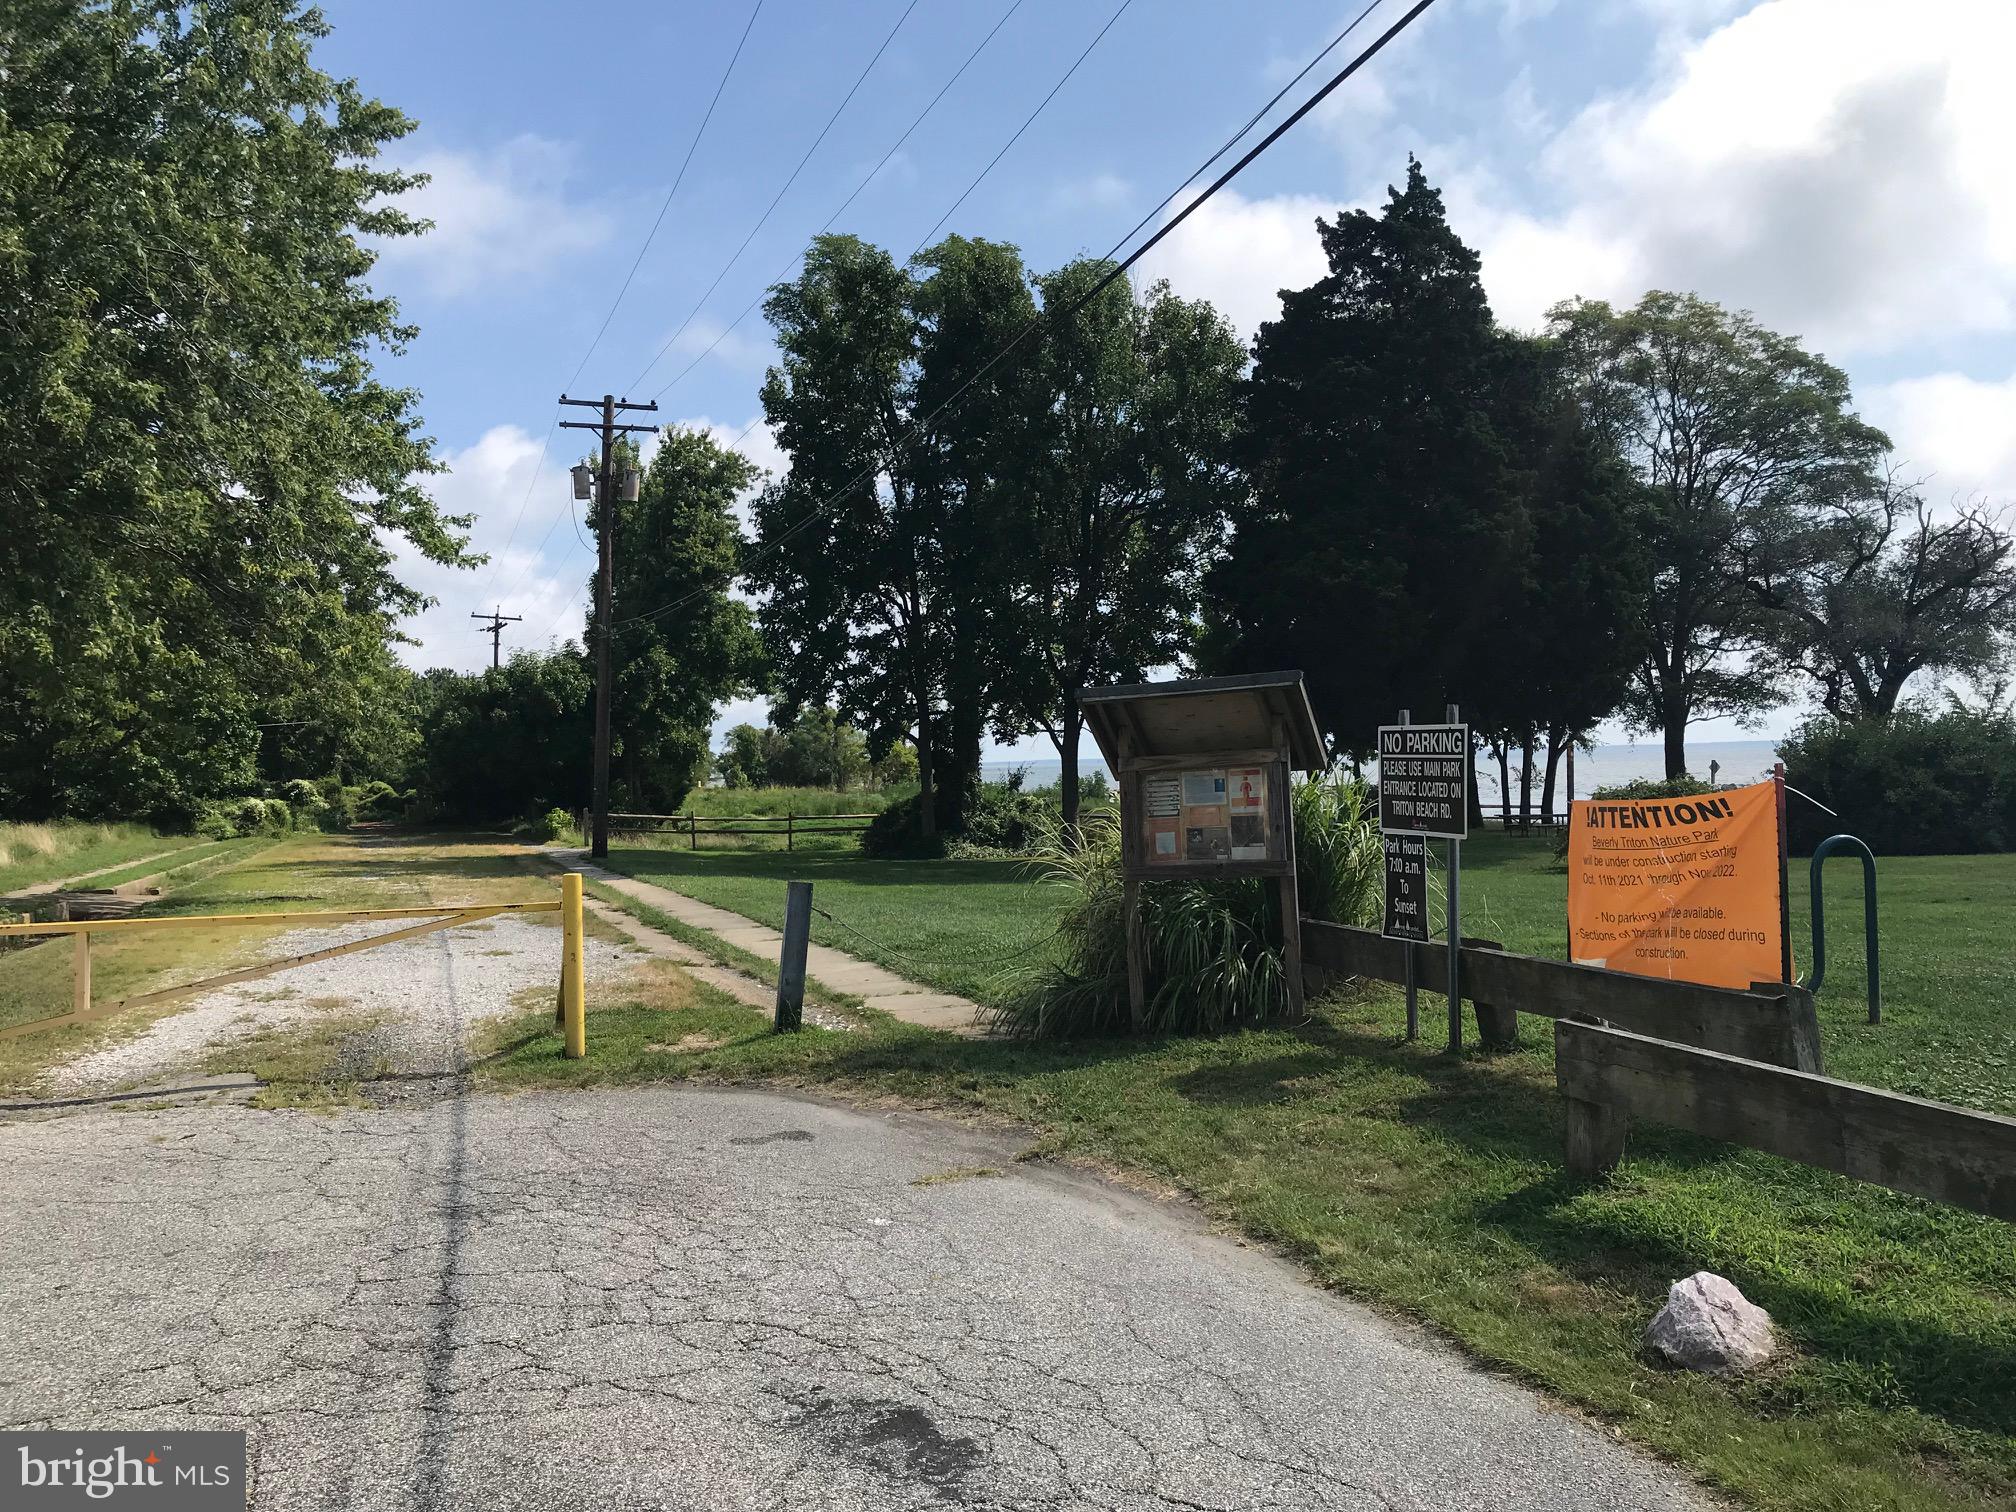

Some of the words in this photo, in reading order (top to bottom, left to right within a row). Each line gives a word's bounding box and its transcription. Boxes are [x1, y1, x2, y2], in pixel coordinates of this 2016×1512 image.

[1384, 733, 1402, 753] NO
[1406, 731, 1462, 753] PARKING
[1383, 760, 1407, 776] PLEASE
[1408, 761, 1422, 776] USE
[1423, 761, 1441, 777] MAIN
[1442, 761, 1461, 778] PARK
[1383, 780, 1417, 796] ENTRANCE
[1418, 781, 1449, 798] LOCATED
[1450, 782, 1462, 799] ON
[1392, 800, 1415, 816] TRITON
[1416, 801, 1439, 818] BEACH
[1440, 803, 1452, 819] RD.
[1586, 797, 1734, 828] !ATTENTION!
[1385, 838, 1400, 854] Park
[1402, 839, 1424, 856] Hours
[1592, 835, 1619, 849] Beverly
[1619, 836, 1649, 848] Triton
[1649, 834, 1691, 848] Nature
[1692, 827, 1719, 841] Park
[1389, 857, 1403, 873] 7:00
[1404, 862, 1421, 875] a.m.
[1594, 856, 1604, 867] be
[1605, 856, 1630, 868] under
[1632, 850, 1697, 868] construction
[1400, 879, 1409, 894] To
[1598, 874, 1616, 886] 11th
[1617, 875, 1644, 887] 2021
[1394, 897, 1417, 915] Sunset
[1601, 911, 1616, 923] No
[1617, 911, 1657, 926] parking
[1682, 907, 1727, 920] available.
[1579, 927, 1617, 941] Sections
[1664, 926, 1678, 939] will
[1679, 927, 1691, 940] be
[1693, 927, 1726, 941] closed
[1728, 928, 1766, 945] during
[1635, 946, 1689, 960] construction.
